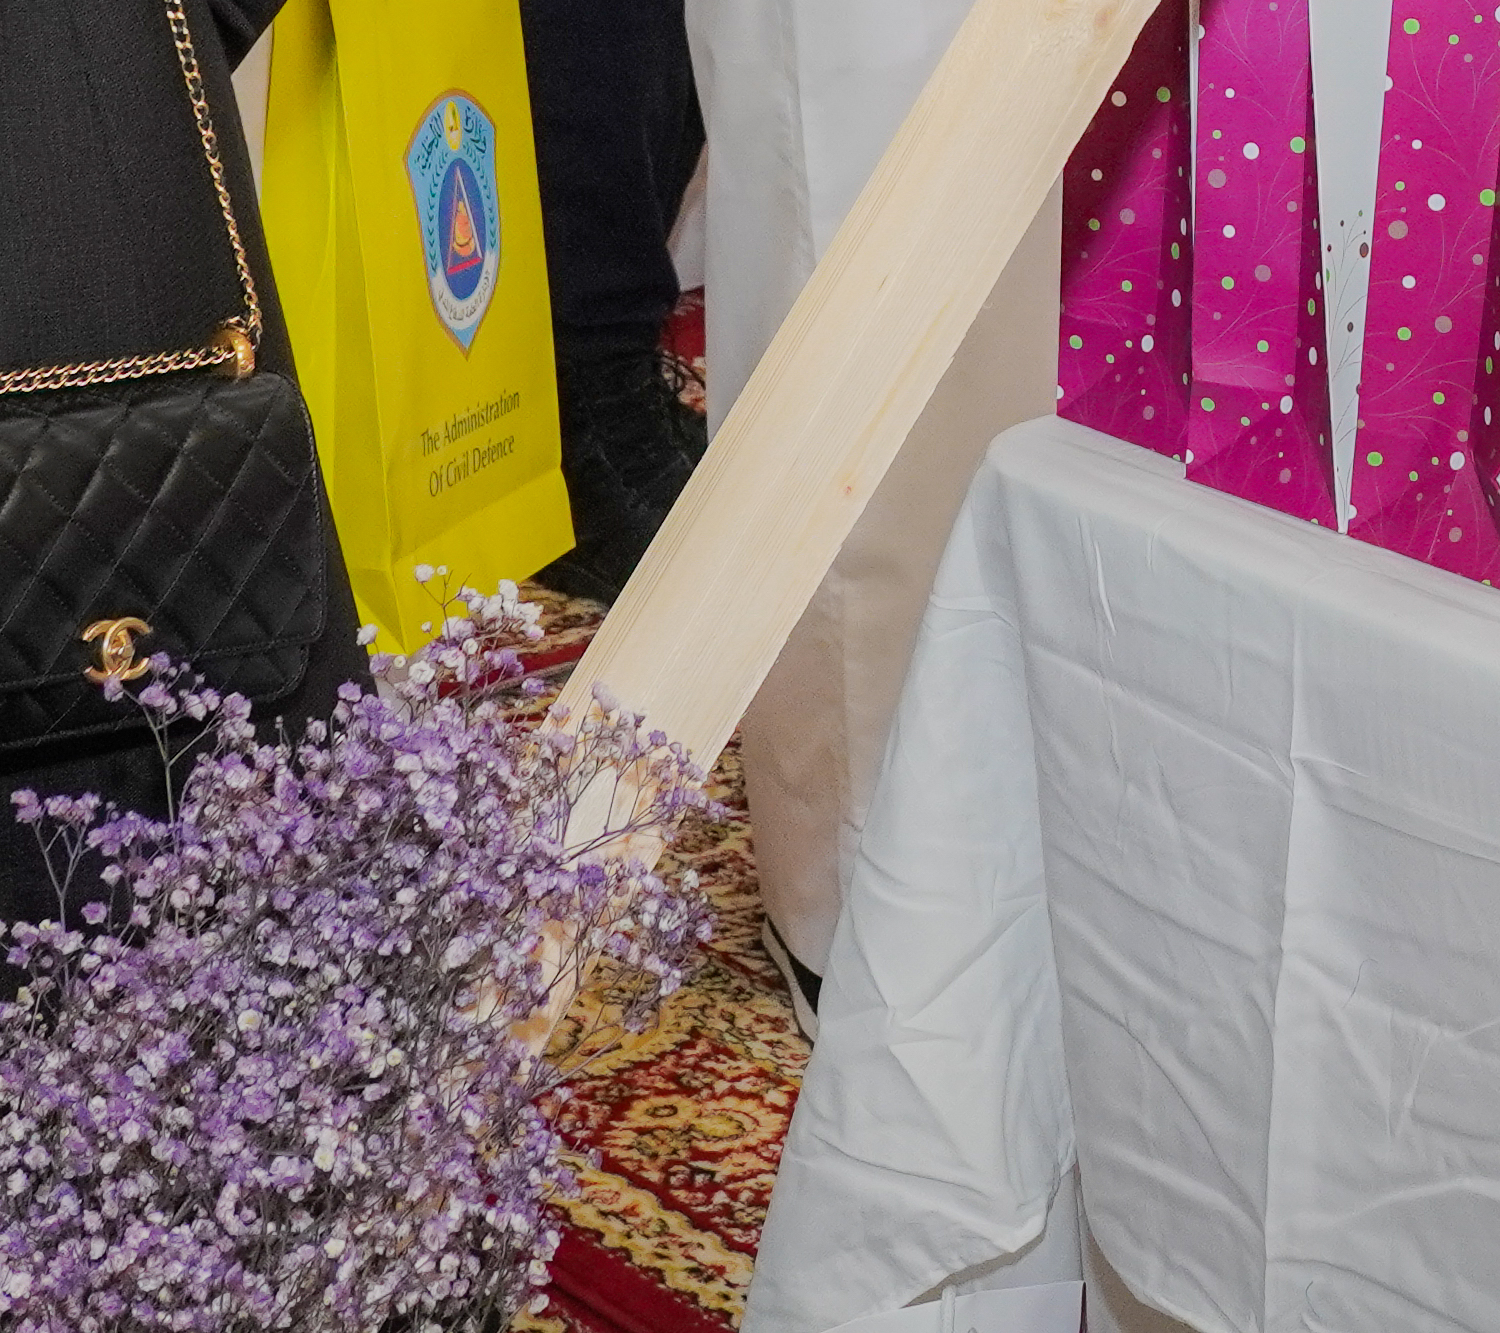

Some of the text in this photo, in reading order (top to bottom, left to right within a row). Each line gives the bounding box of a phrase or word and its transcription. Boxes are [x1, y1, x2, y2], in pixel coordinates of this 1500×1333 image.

[421, 388, 520, 457] The Administration
[429, 435, 515, 497] Of Civil Defence
